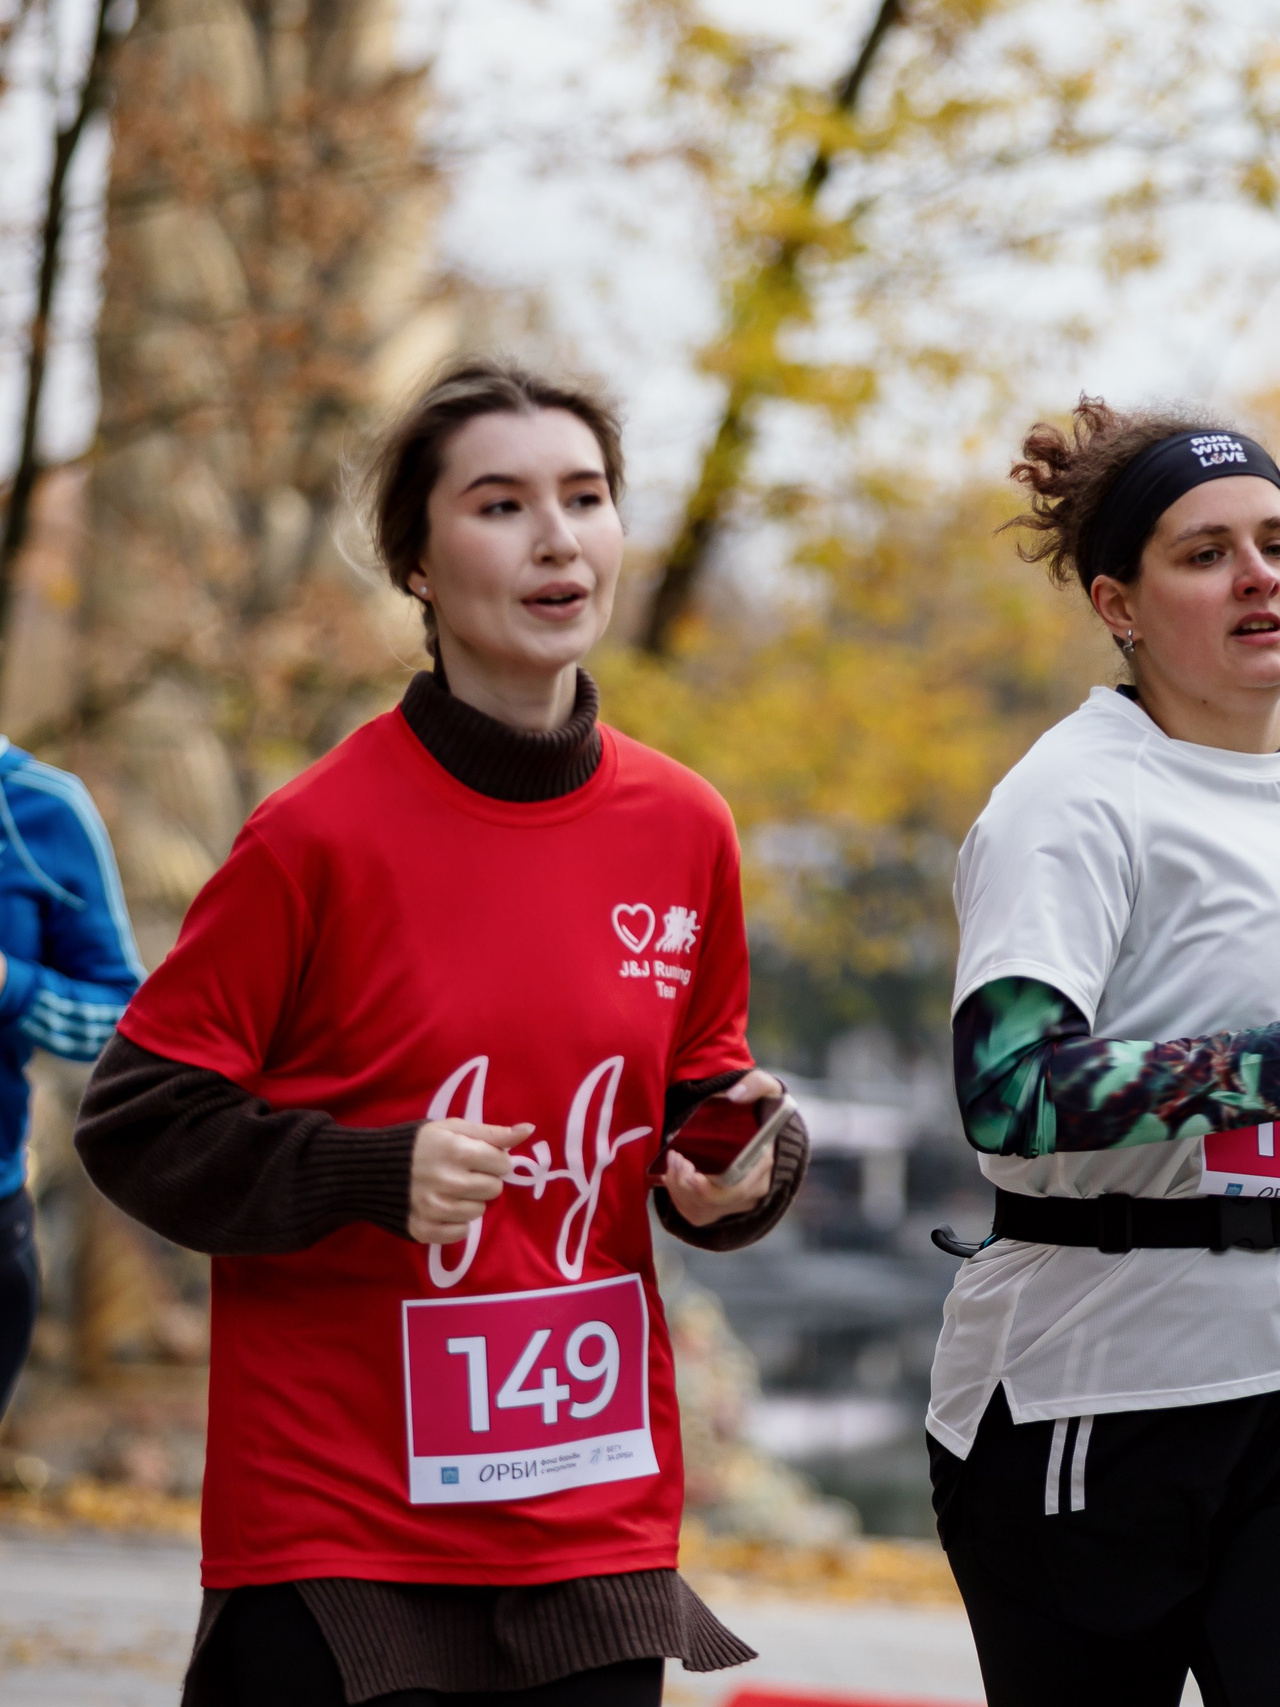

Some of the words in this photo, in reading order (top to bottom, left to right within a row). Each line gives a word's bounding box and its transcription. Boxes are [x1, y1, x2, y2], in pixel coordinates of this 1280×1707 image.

[1190, 435, 1232, 446] RUN
[1191, 442, 1243, 456] WITH
[1200, 452, 1248, 467] LOVE
[618, 960, 650, 978] J&J
[446, 1320, 620, 1432] 149
[479, 1460, 538, 1482] ОРБИ
